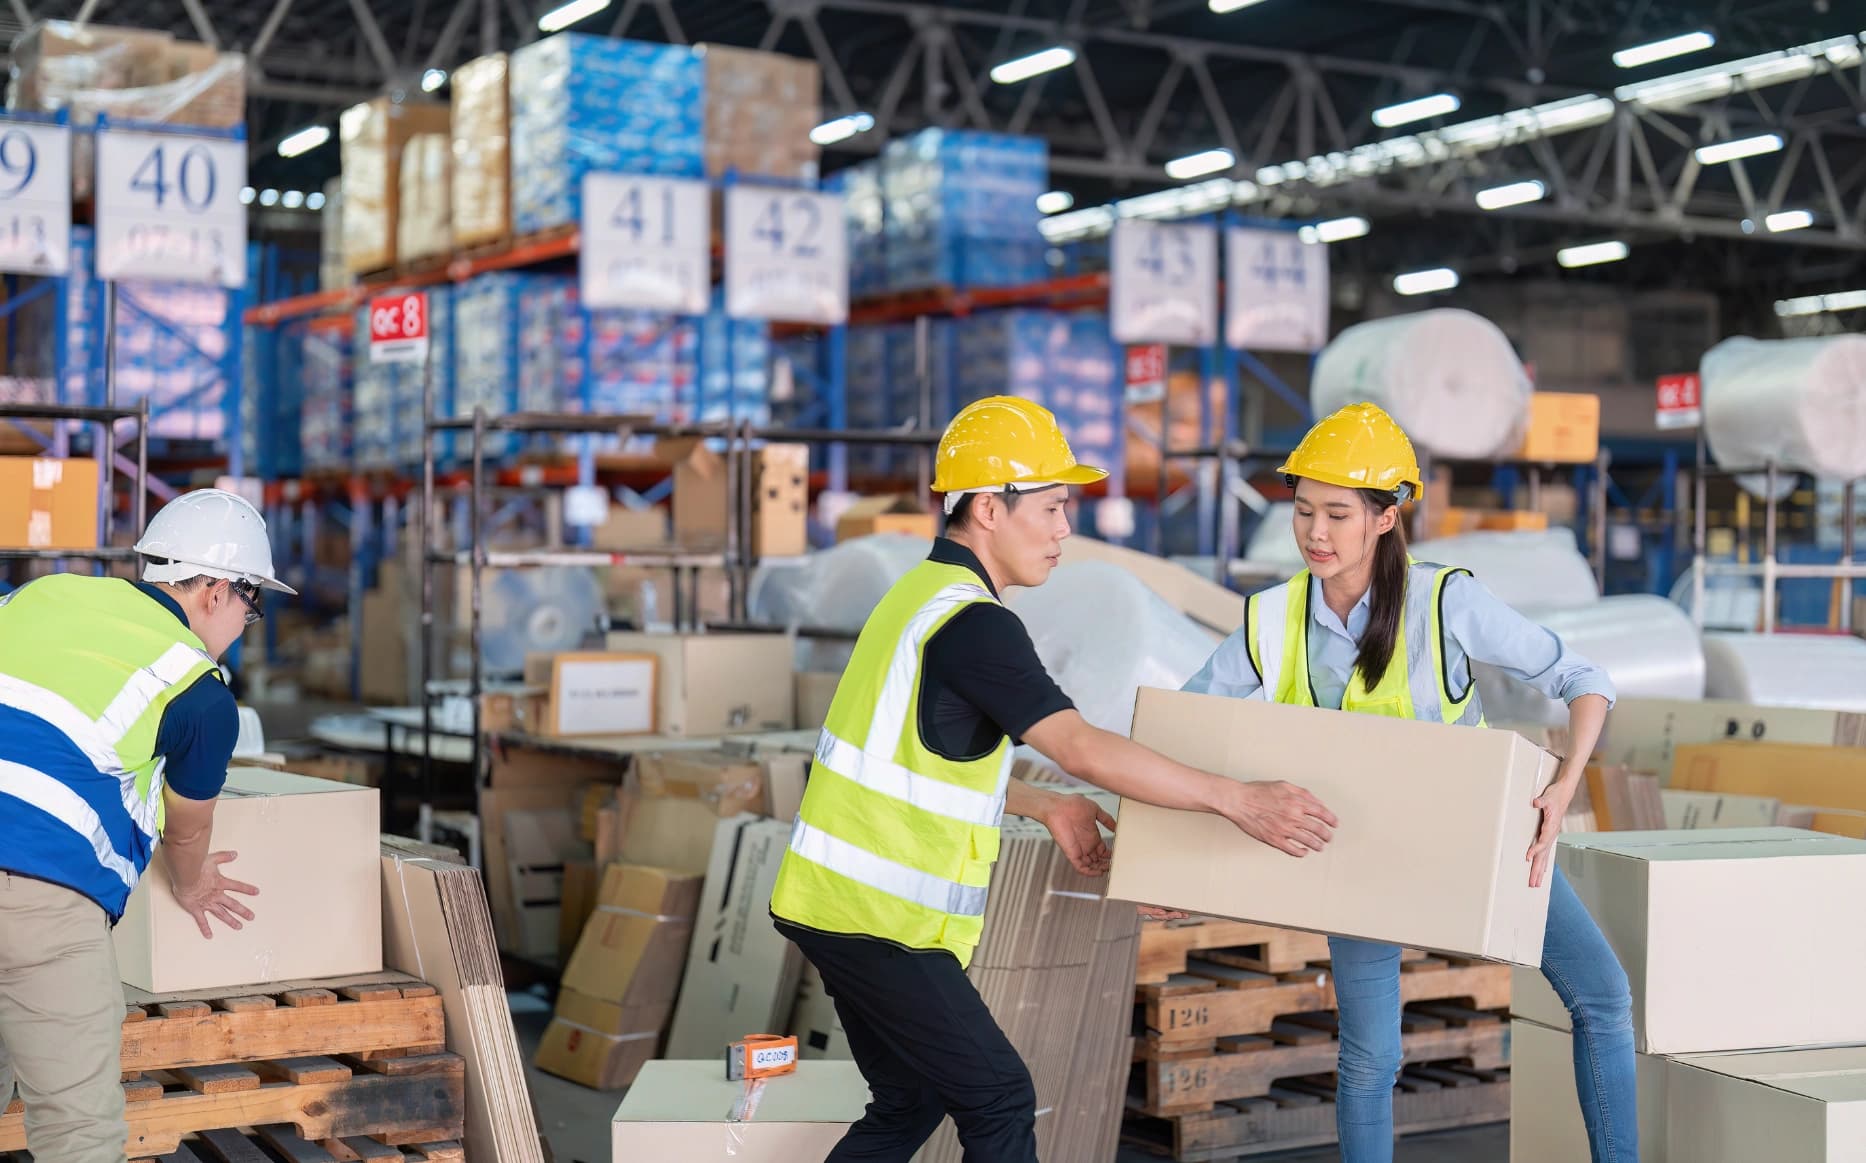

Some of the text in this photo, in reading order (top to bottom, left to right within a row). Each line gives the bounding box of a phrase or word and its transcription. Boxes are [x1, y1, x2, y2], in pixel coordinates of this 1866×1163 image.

[129, 143, 217, 215] 40
[608, 185, 676, 247] 41
[753, 196, 823, 258] 42
[402, 295, 421, 337] 8
[1169, 1007, 1209, 1030] 126
[1168, 1066, 1208, 1094] 126
